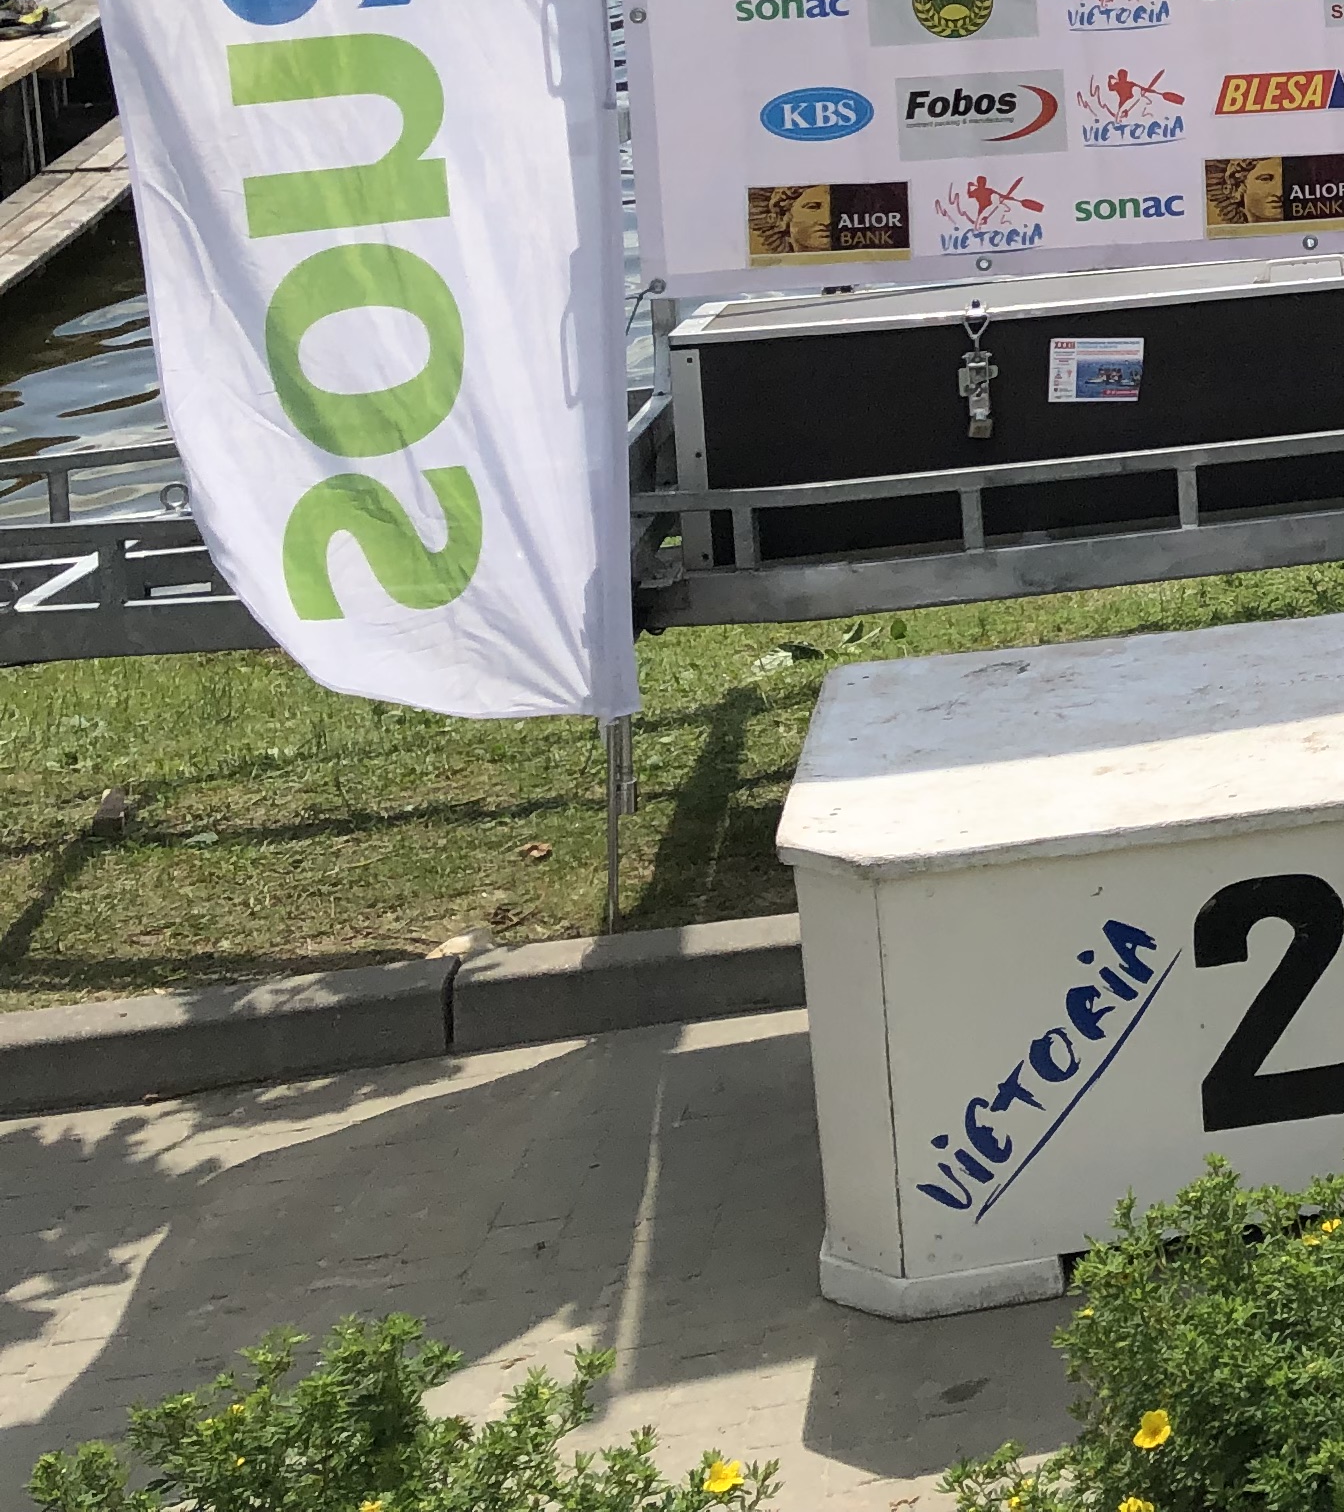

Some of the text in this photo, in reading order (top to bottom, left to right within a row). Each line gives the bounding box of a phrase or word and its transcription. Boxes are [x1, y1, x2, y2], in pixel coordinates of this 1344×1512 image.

[905, 89, 1017, 120] Fobos
[1222, 74, 1324, 112] BLESA
[781, 99, 857, 129] KBS
[838, 213, 902, 228] ALIOR
[1075, 194, 1185, 222] sonac
[1292, 201, 1343, 216] BANK
[841, 231, 893, 246] BANK
